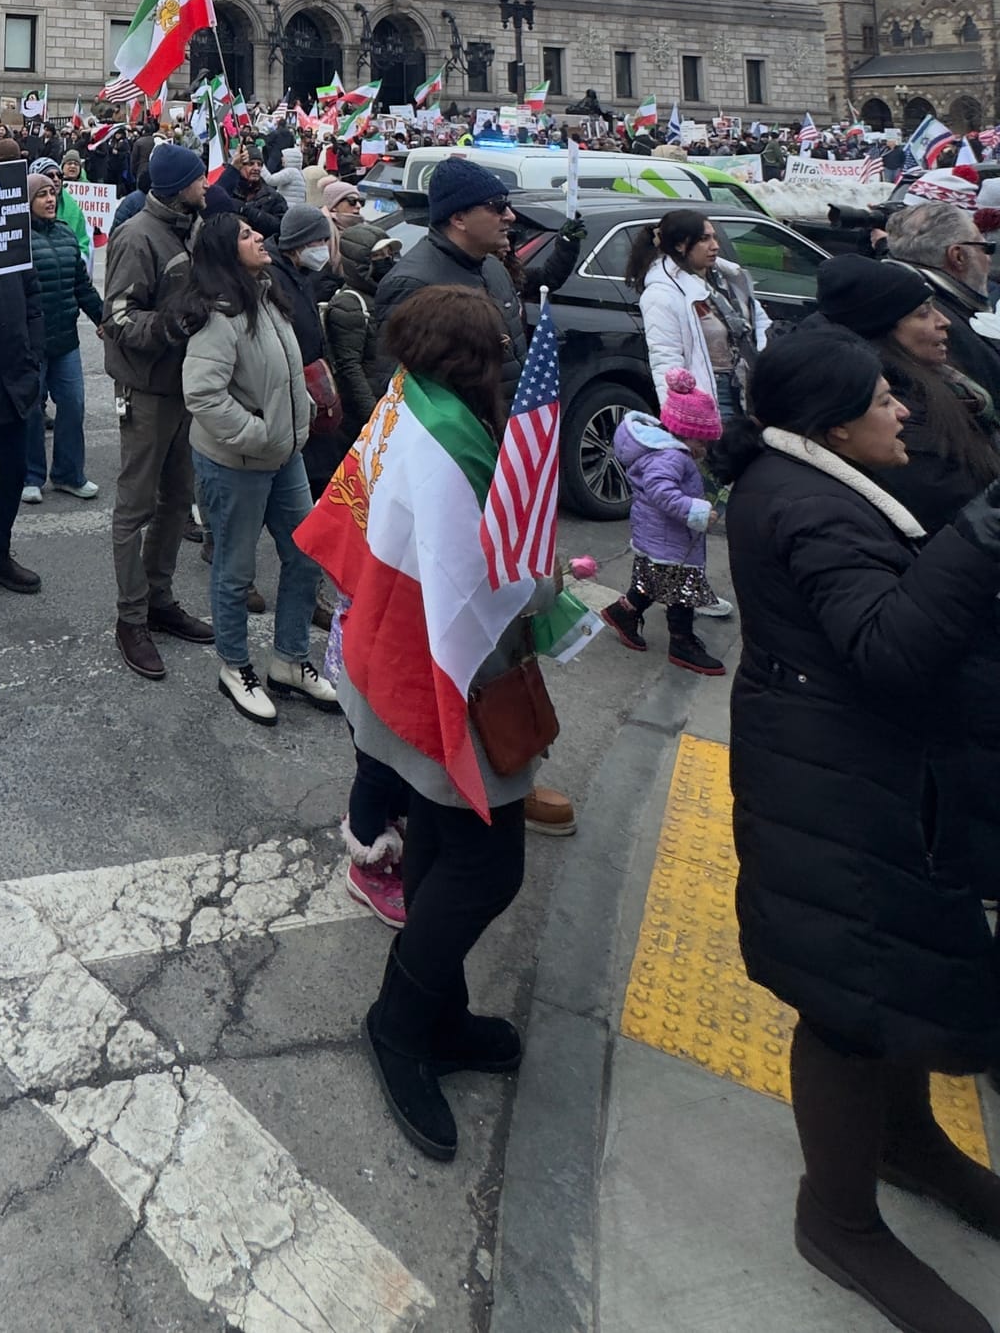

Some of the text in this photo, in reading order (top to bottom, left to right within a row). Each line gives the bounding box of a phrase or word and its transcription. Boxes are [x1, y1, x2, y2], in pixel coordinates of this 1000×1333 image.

[69, 184, 108, 197] STOP THE
[1, 202, 29, 216] CHANGE
[78, 200, 110, 213] UGHTER
[87, 216, 103, 227] RAN
